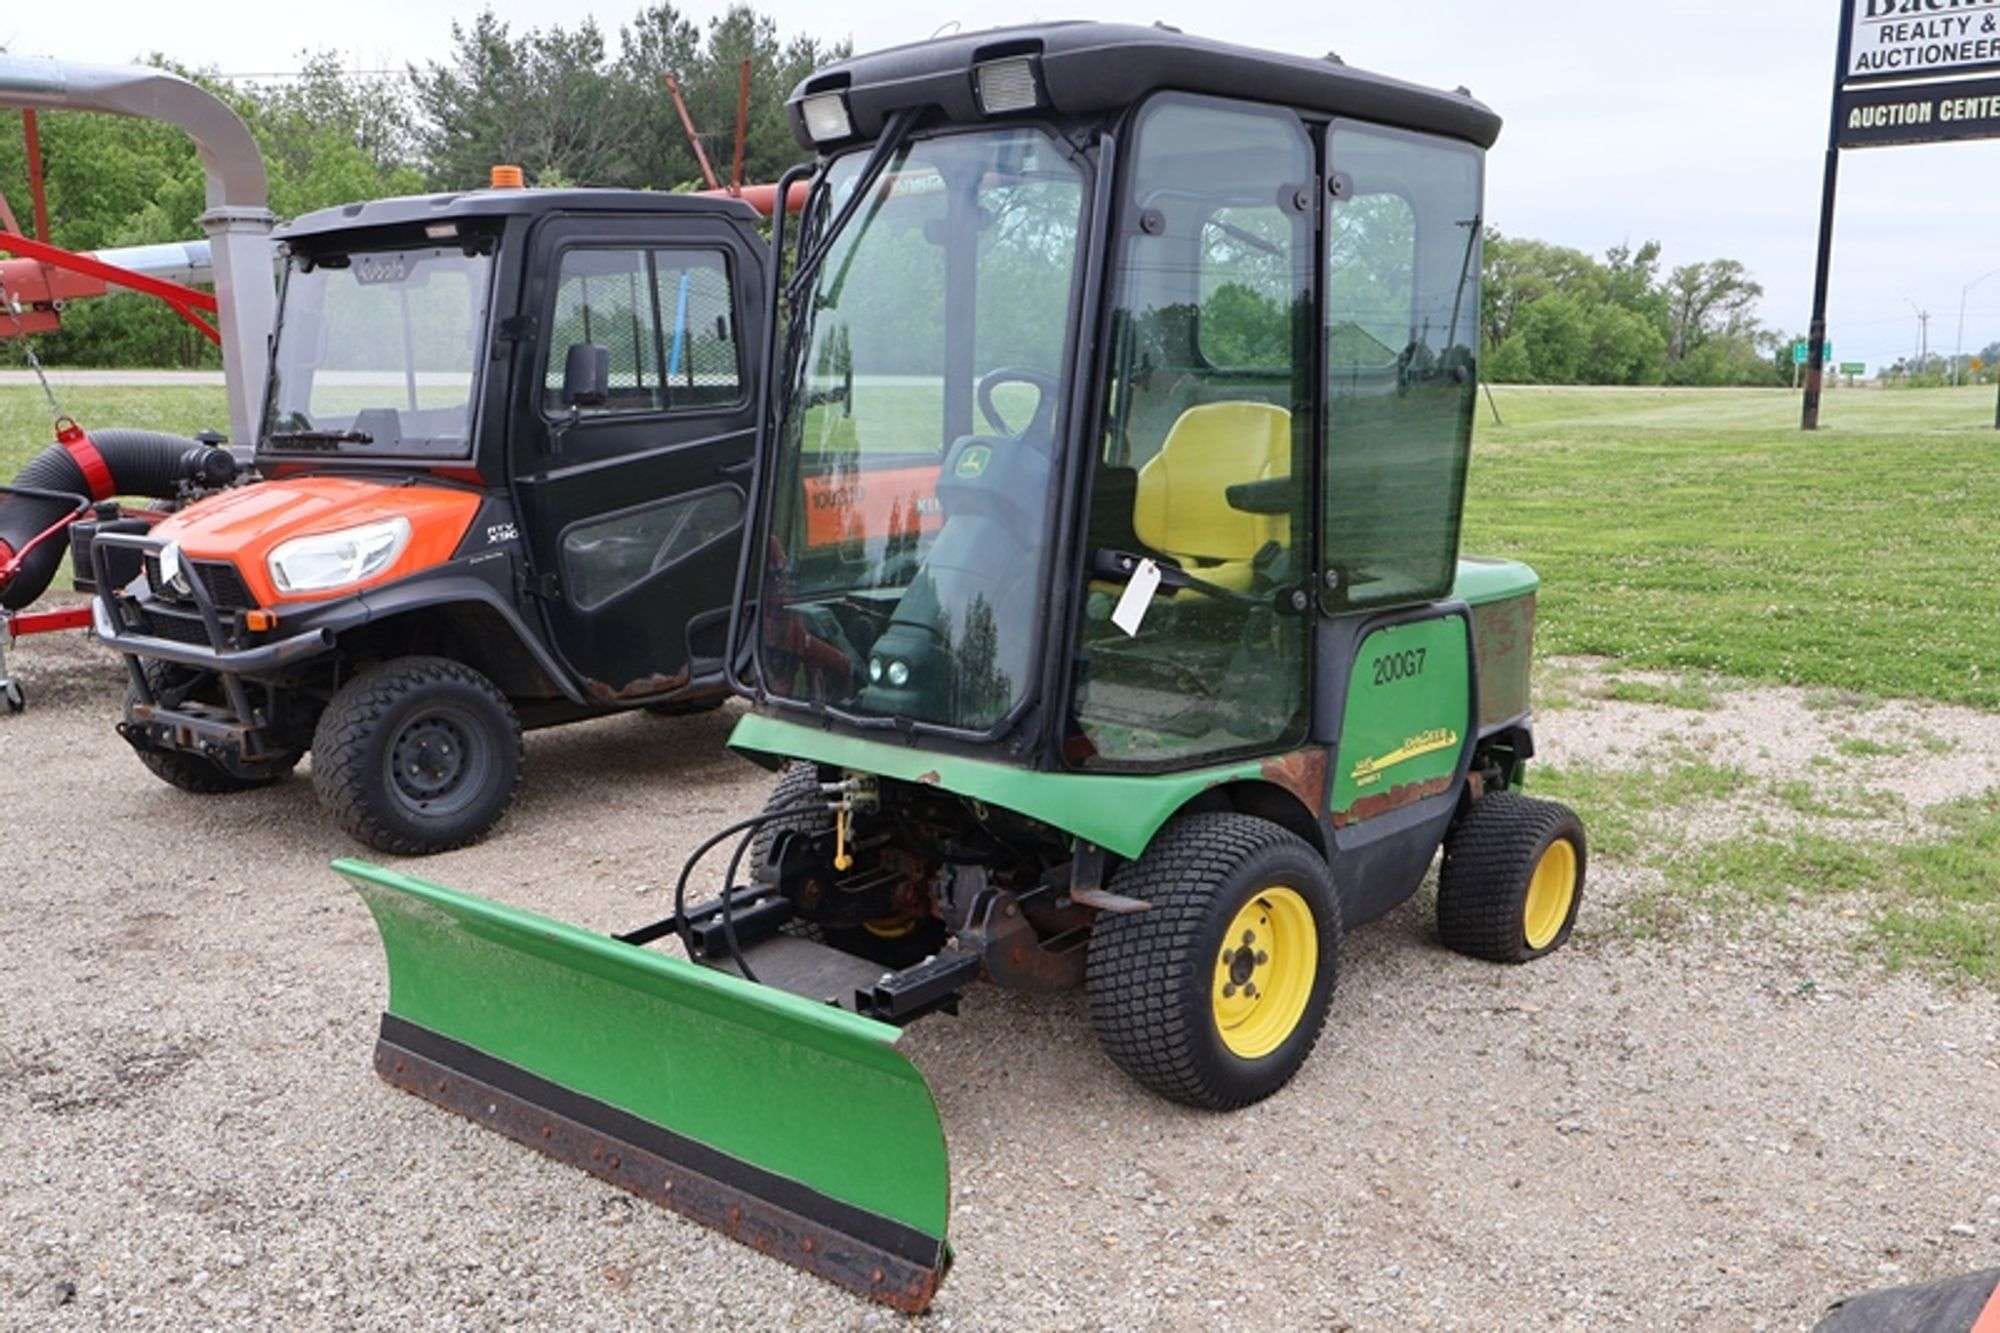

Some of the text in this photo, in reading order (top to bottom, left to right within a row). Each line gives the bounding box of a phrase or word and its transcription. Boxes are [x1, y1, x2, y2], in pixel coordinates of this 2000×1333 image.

[1880, 13, 1996, 43] REALTY &
[1848, 96, 2000, 128] AUCTION CENTE
[1373, 648, 1427, 686] 200G7
